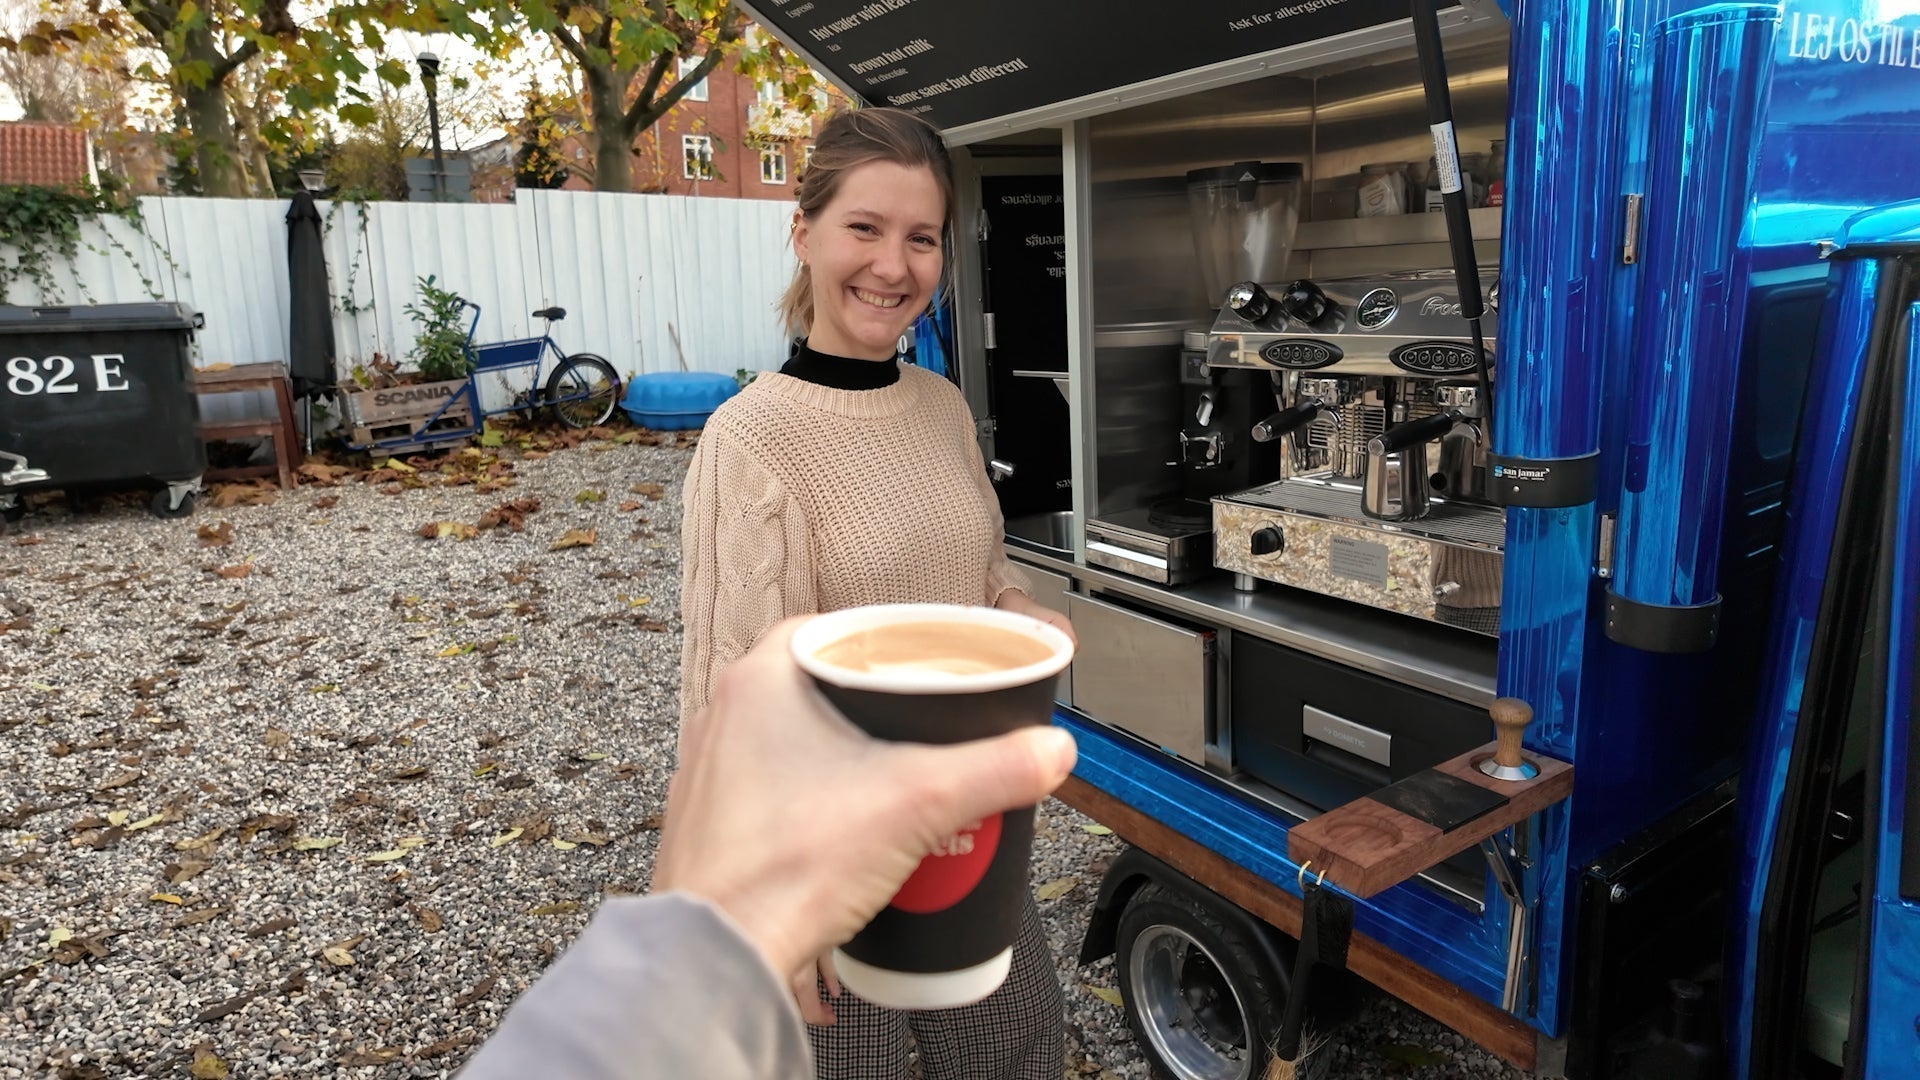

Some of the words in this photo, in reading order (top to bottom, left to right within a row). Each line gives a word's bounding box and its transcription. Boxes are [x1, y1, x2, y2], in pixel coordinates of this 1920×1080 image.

[809, 24, 834, 42] Hot
[829, 14, 862, 35] water
[857, 2, 889, 22] with
[881, 0, 917, 12] lea
[1228, 17, 1254, 32] Ask
[1250, 12, 1274, 26] for
[826, 43, 842, 53] Tea
[1789, 12, 1836, 61] LEJ
[1839, 18, 1872, 64] OS
[1878, 23, 1907, 67] TIL
[849, 54, 887, 75] Brown
[882, 48, 907, 65] hot
[904, 38, 935, 57] milk
[887, 89, 922, 107] Same
[918, 79, 950, 99] same
[946, 73, 973, 90] but
[969, 57, 1029, 83] different
[1025, 233, 1065, 247] arengs
[6, 355, 79, 396] 82
[90, 353, 129, 392] E
[374, 385, 454, 407] SCANIA
[1503, 467, 1517, 476] san
[1518, 468, 1547, 478] jamar
